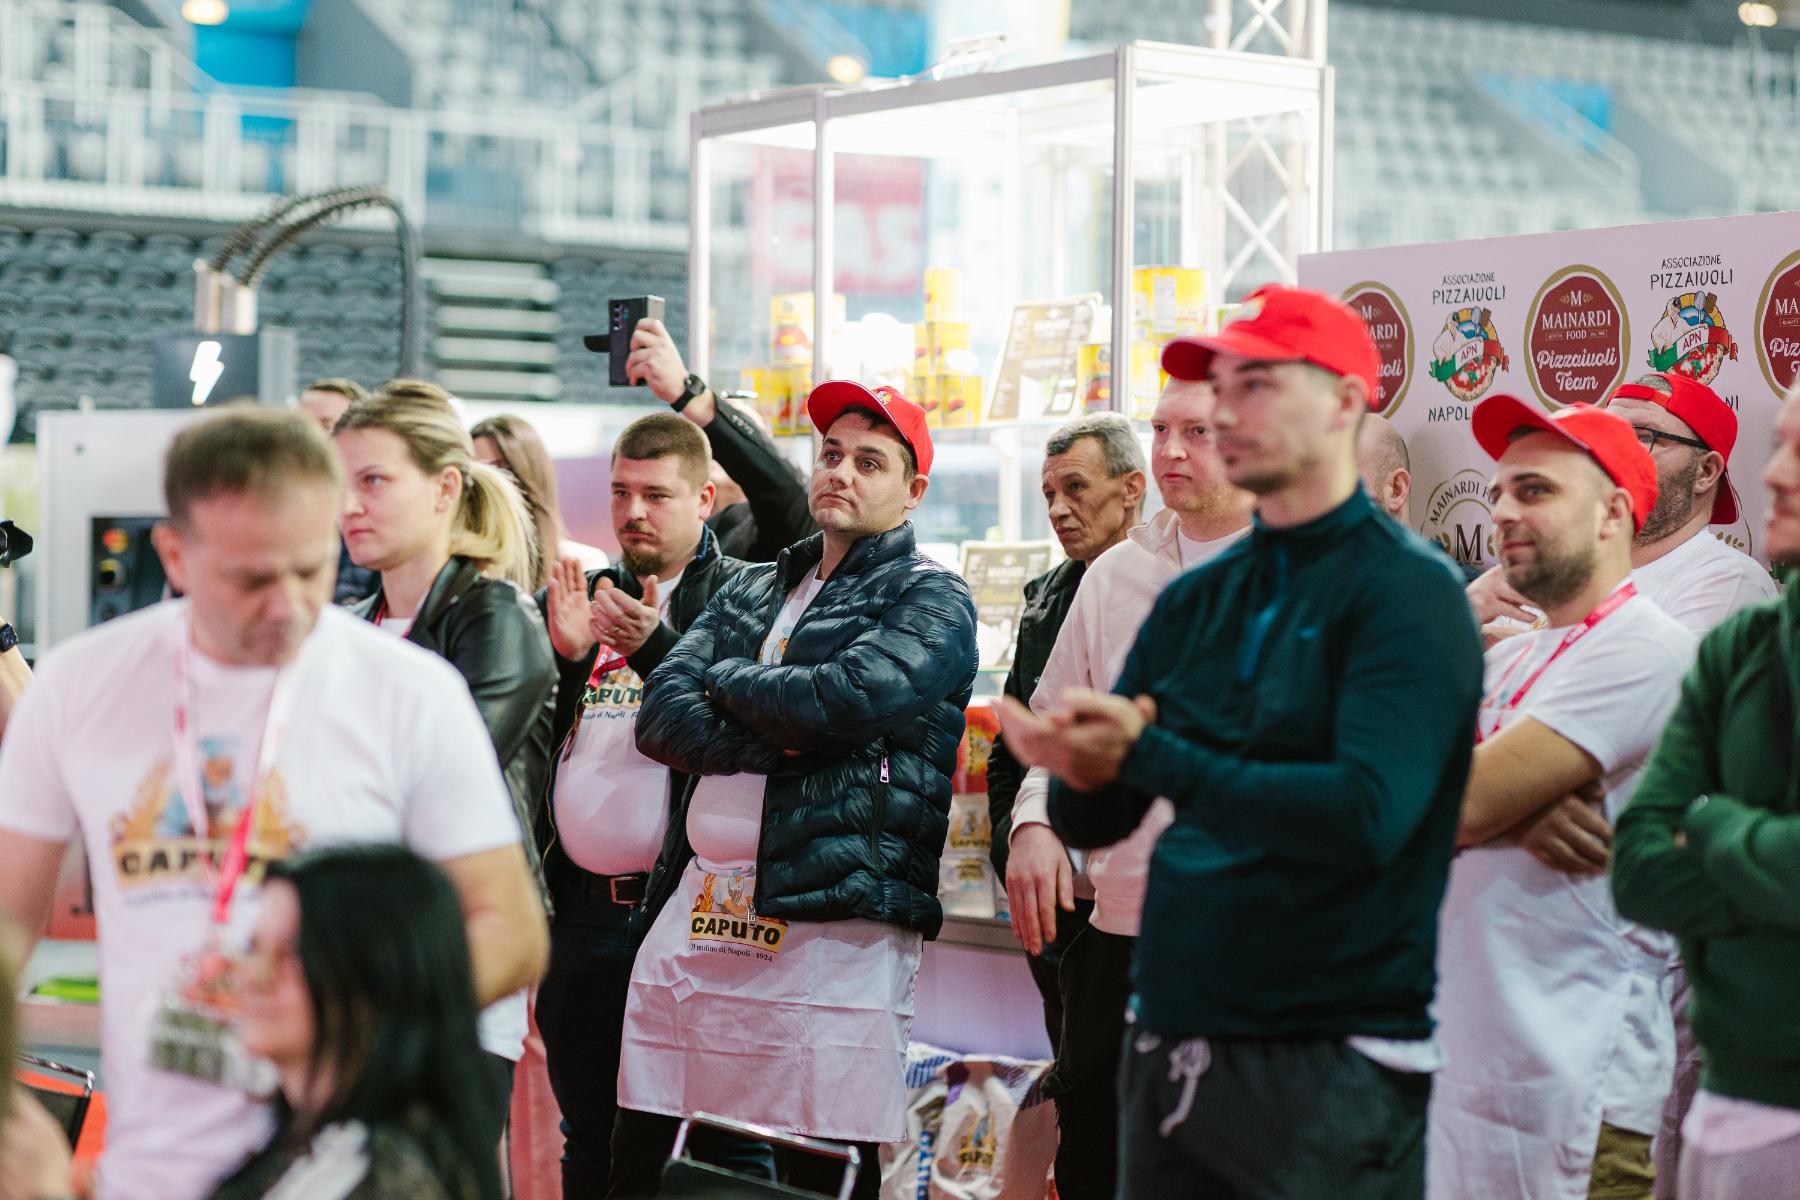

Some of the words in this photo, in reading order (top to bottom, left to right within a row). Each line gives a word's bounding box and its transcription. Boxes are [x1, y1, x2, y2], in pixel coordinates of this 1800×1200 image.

[1661, 254, 1722, 269] ASSOCIAZIONE
[1442, 272, 1496, 286] ASSOCIAZIONE
[1650, 268, 1733, 290] PIZZAIUOLI
[1432, 285, 1506, 304] PIZZAIUOLI
[1570, 289, 1582, 307] M
[1361, 304, 1373, 321] M
[1542, 309, 1611, 330] MAINARDI
[1369, 324, 1398, 340] ARDI
[1566, 329, 1587, 340] FOOD
[1683, 330, 1702, 350] APN
[1461, 343, 1478, 362] APN
[1536, 346, 1617, 370] Pizzaiuoli
[1555, 370, 1599, 392] Team
[1428, 405, 1471, 422] NAPOL
[1429, 480, 1480, 525] MAINARDI
[1455, 523, 1483, 563] M
[589, 687, 643, 704] APUT
[691, 916, 781, 946] CAPUTO
[727, 947, 751, 958] Napoli
[756, 952, 773, 962] 1924
